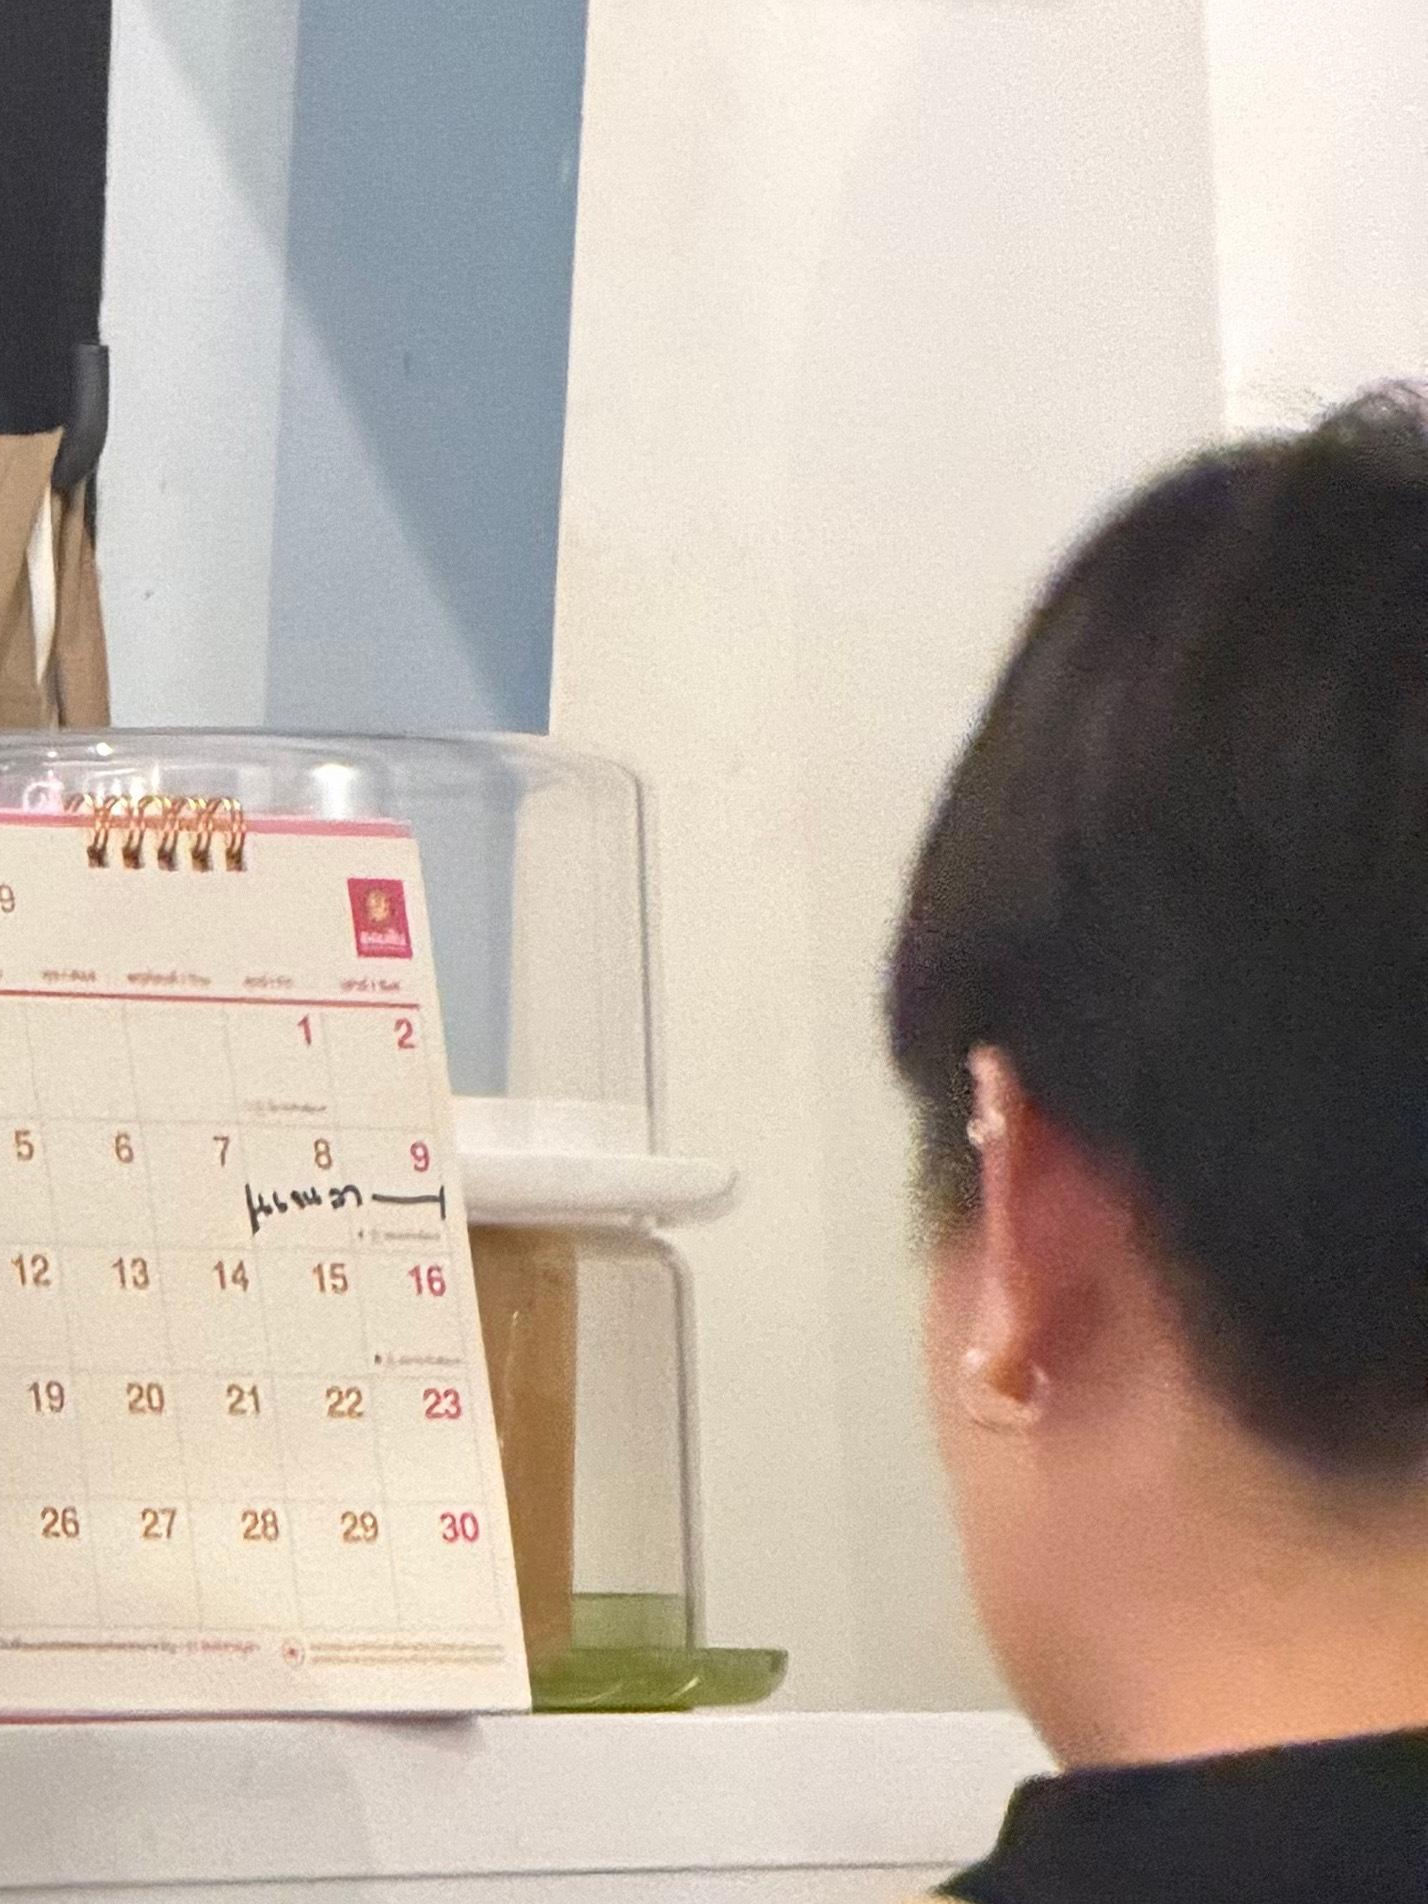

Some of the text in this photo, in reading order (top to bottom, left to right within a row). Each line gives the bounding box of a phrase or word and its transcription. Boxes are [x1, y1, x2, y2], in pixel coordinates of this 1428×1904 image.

[298, 1016, 415, 1049] 1 2
[15, 1130, 34, 1161] 5
[115, 1133, 134, 1163] 6
[213, 1136, 230, 1167] 7
[314, 1138, 333, 1170] 8
[410, 1142, 430, 1173] 9
[12, 1254, 50, 1286] 12
[112, 1257, 149, 1289] 13
[214, 1260, 249, 1291] 14
[313, 1263, 348, 1293] 15
[409, 1266, 446, 1296] 16
[29, 1381, 64, 1412] 19
[126, 1383, 164, 1414] 20
[227, 1384, 260, 1415] 21
[326, 1386, 364, 1418] 22
[423, 1388, 462, 1419] 23
[41, 1507, 79, 1538] 26
[141, 1508, 176, 1539] 27
[242, 1509, 279, 1542] 28
[341, 1511, 378, 1543] 29
[440, 1512, 479, 1543] 30
